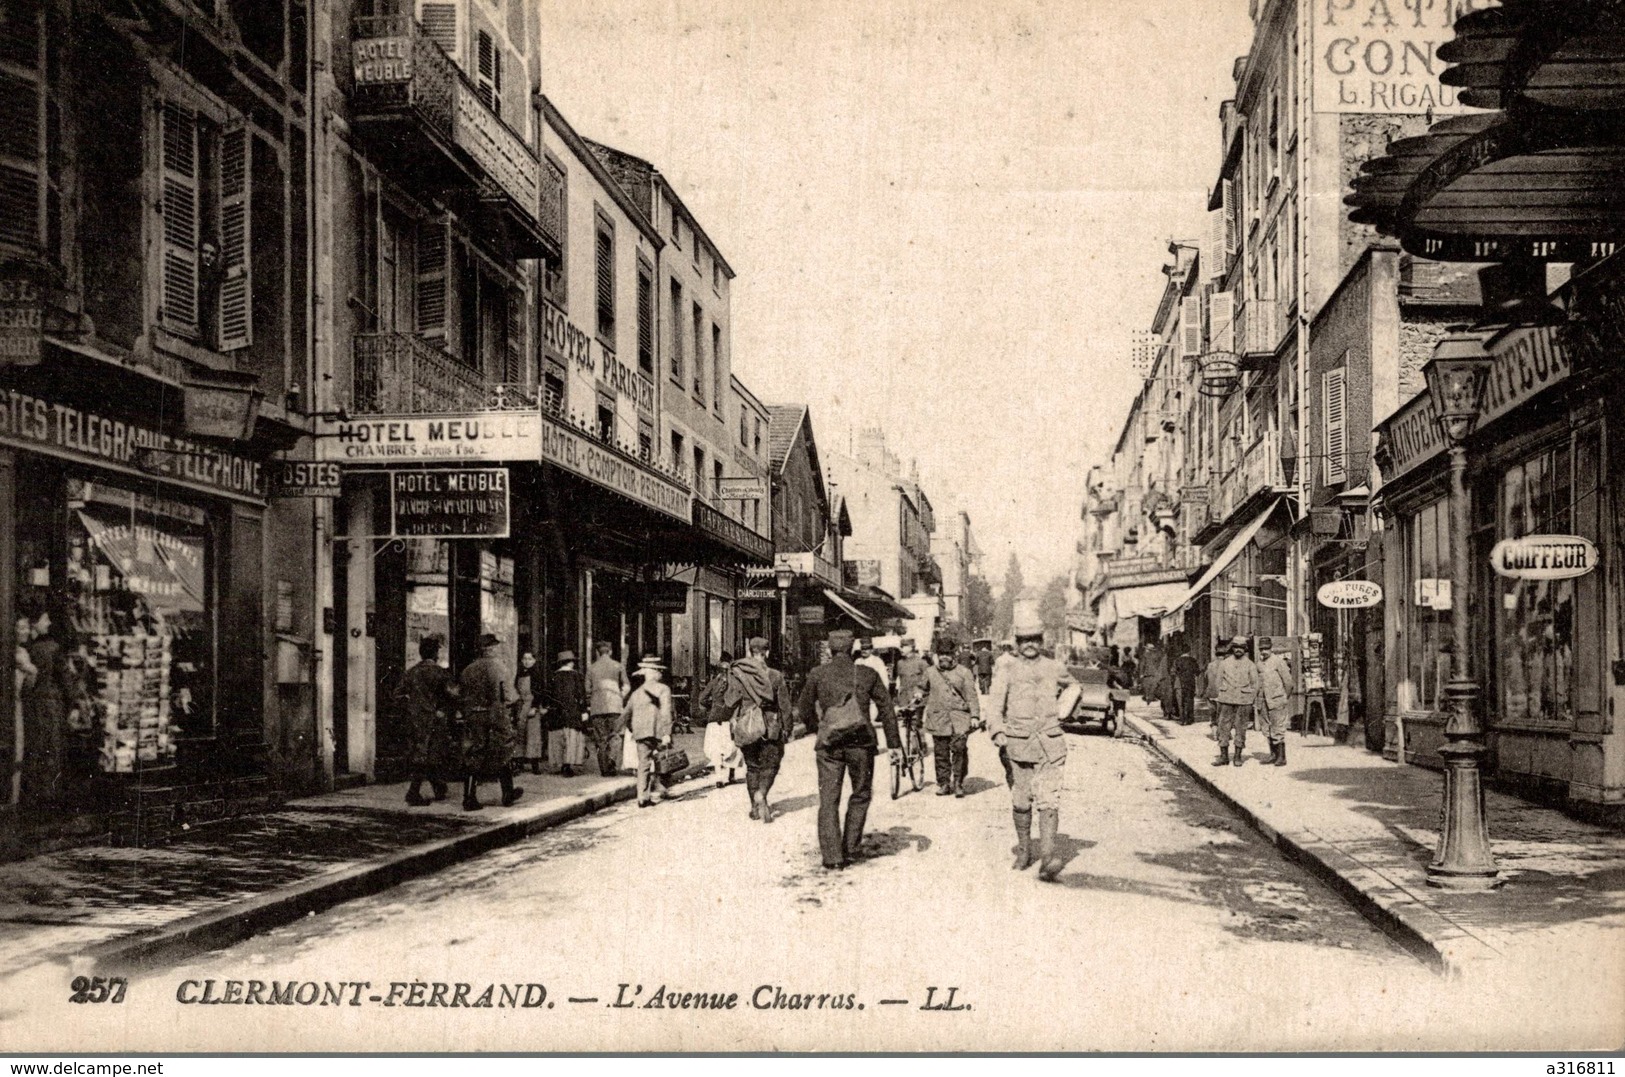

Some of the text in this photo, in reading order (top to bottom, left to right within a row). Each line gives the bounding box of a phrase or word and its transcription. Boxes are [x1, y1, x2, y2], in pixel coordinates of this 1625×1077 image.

[357, 40, 405, 59] HOTEL
[1324, 36, 1449, 76] CON
[1370, 81, 1462, 110] RIGAU
[544, 303, 654, 413] HOTEL PARISIEN
[340, 423, 415, 442] HOTEL
[346, 444, 417, 458] CHAMBRES
[542, 423, 580, 468] HOTEL
[175, 439, 261, 495] TELEPHONE
[398, 474, 441, 492] HOTEL
[1503, 543, 1588, 570] COIFFEUR
[738, 589, 776, 598] CHARCUTERIE
[1332, 595, 1369, 606] DAMES
